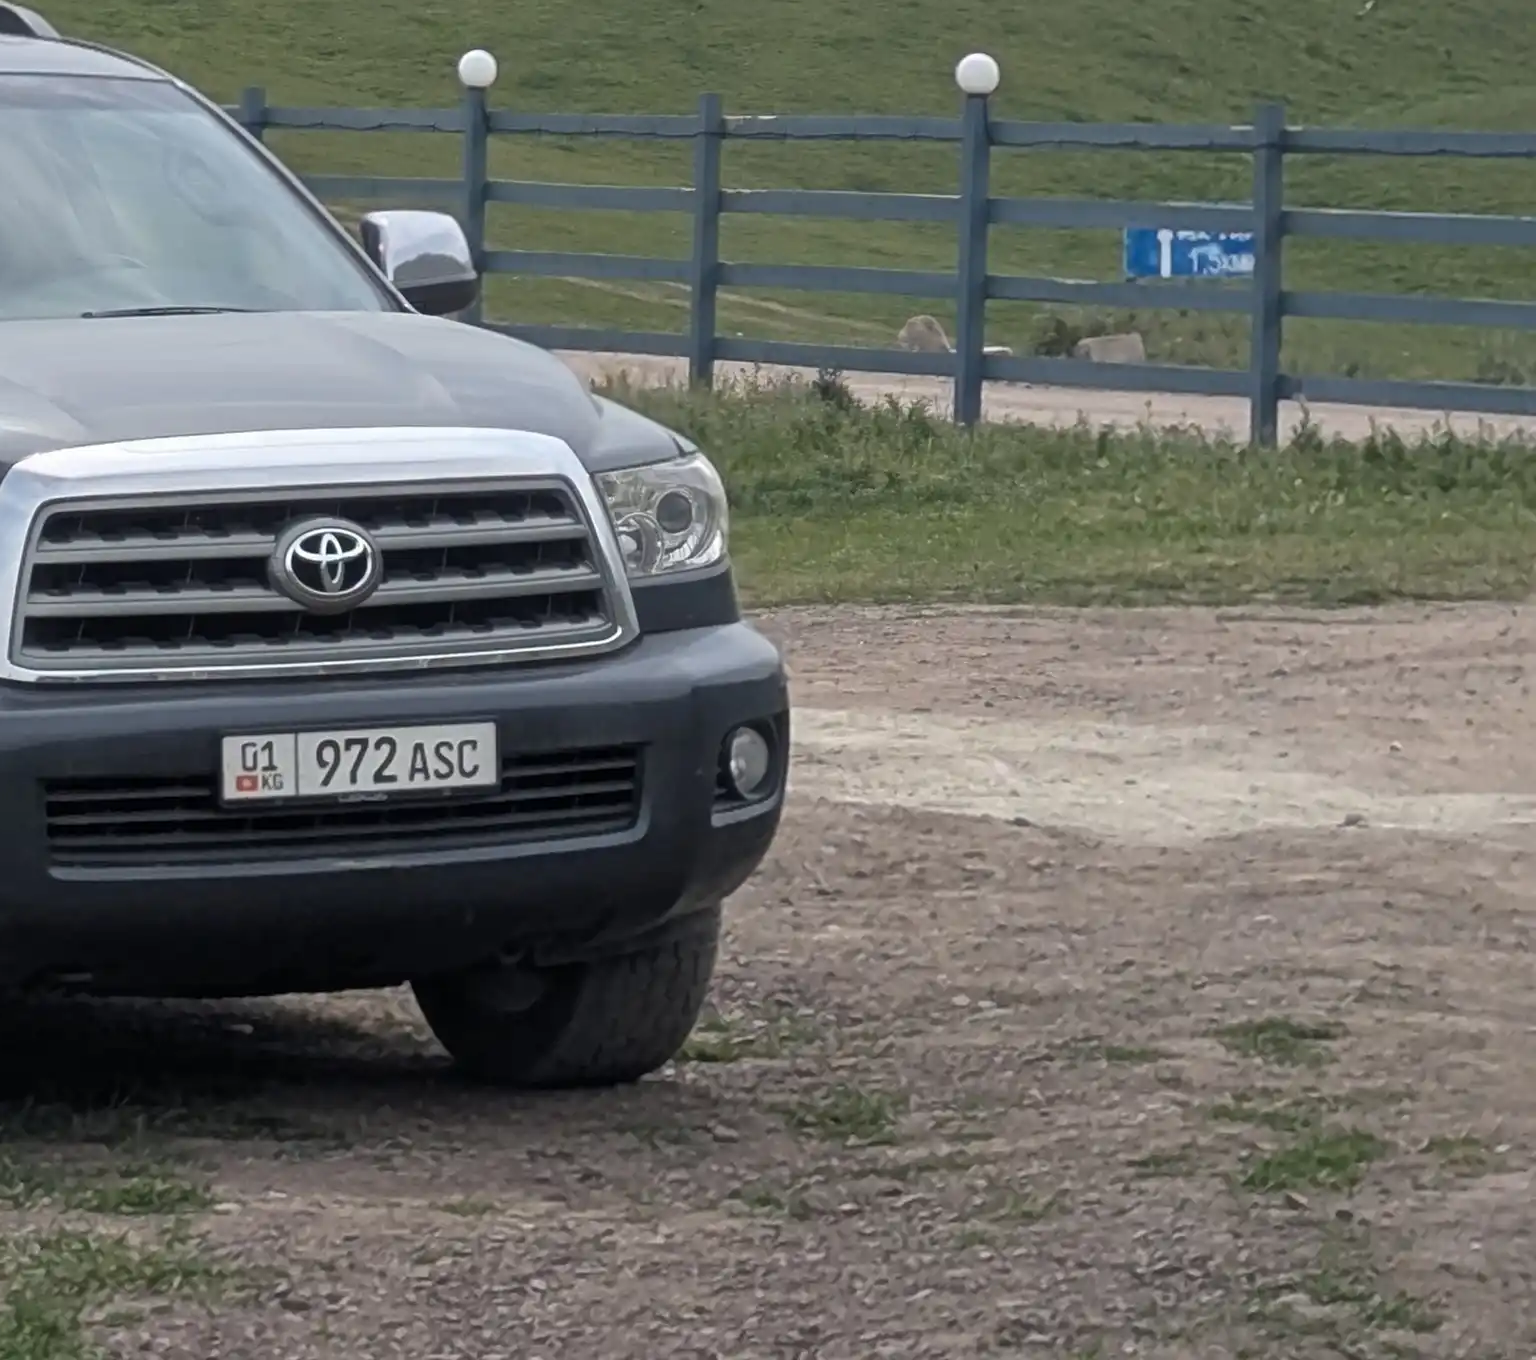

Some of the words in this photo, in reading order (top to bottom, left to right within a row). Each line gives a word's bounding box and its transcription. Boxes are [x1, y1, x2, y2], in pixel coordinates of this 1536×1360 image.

[241, 741, 278, 771] 01
[316, 736, 398, 787] 972
[409, 739, 480, 781] ASC
[261, 773, 284, 791] KG
